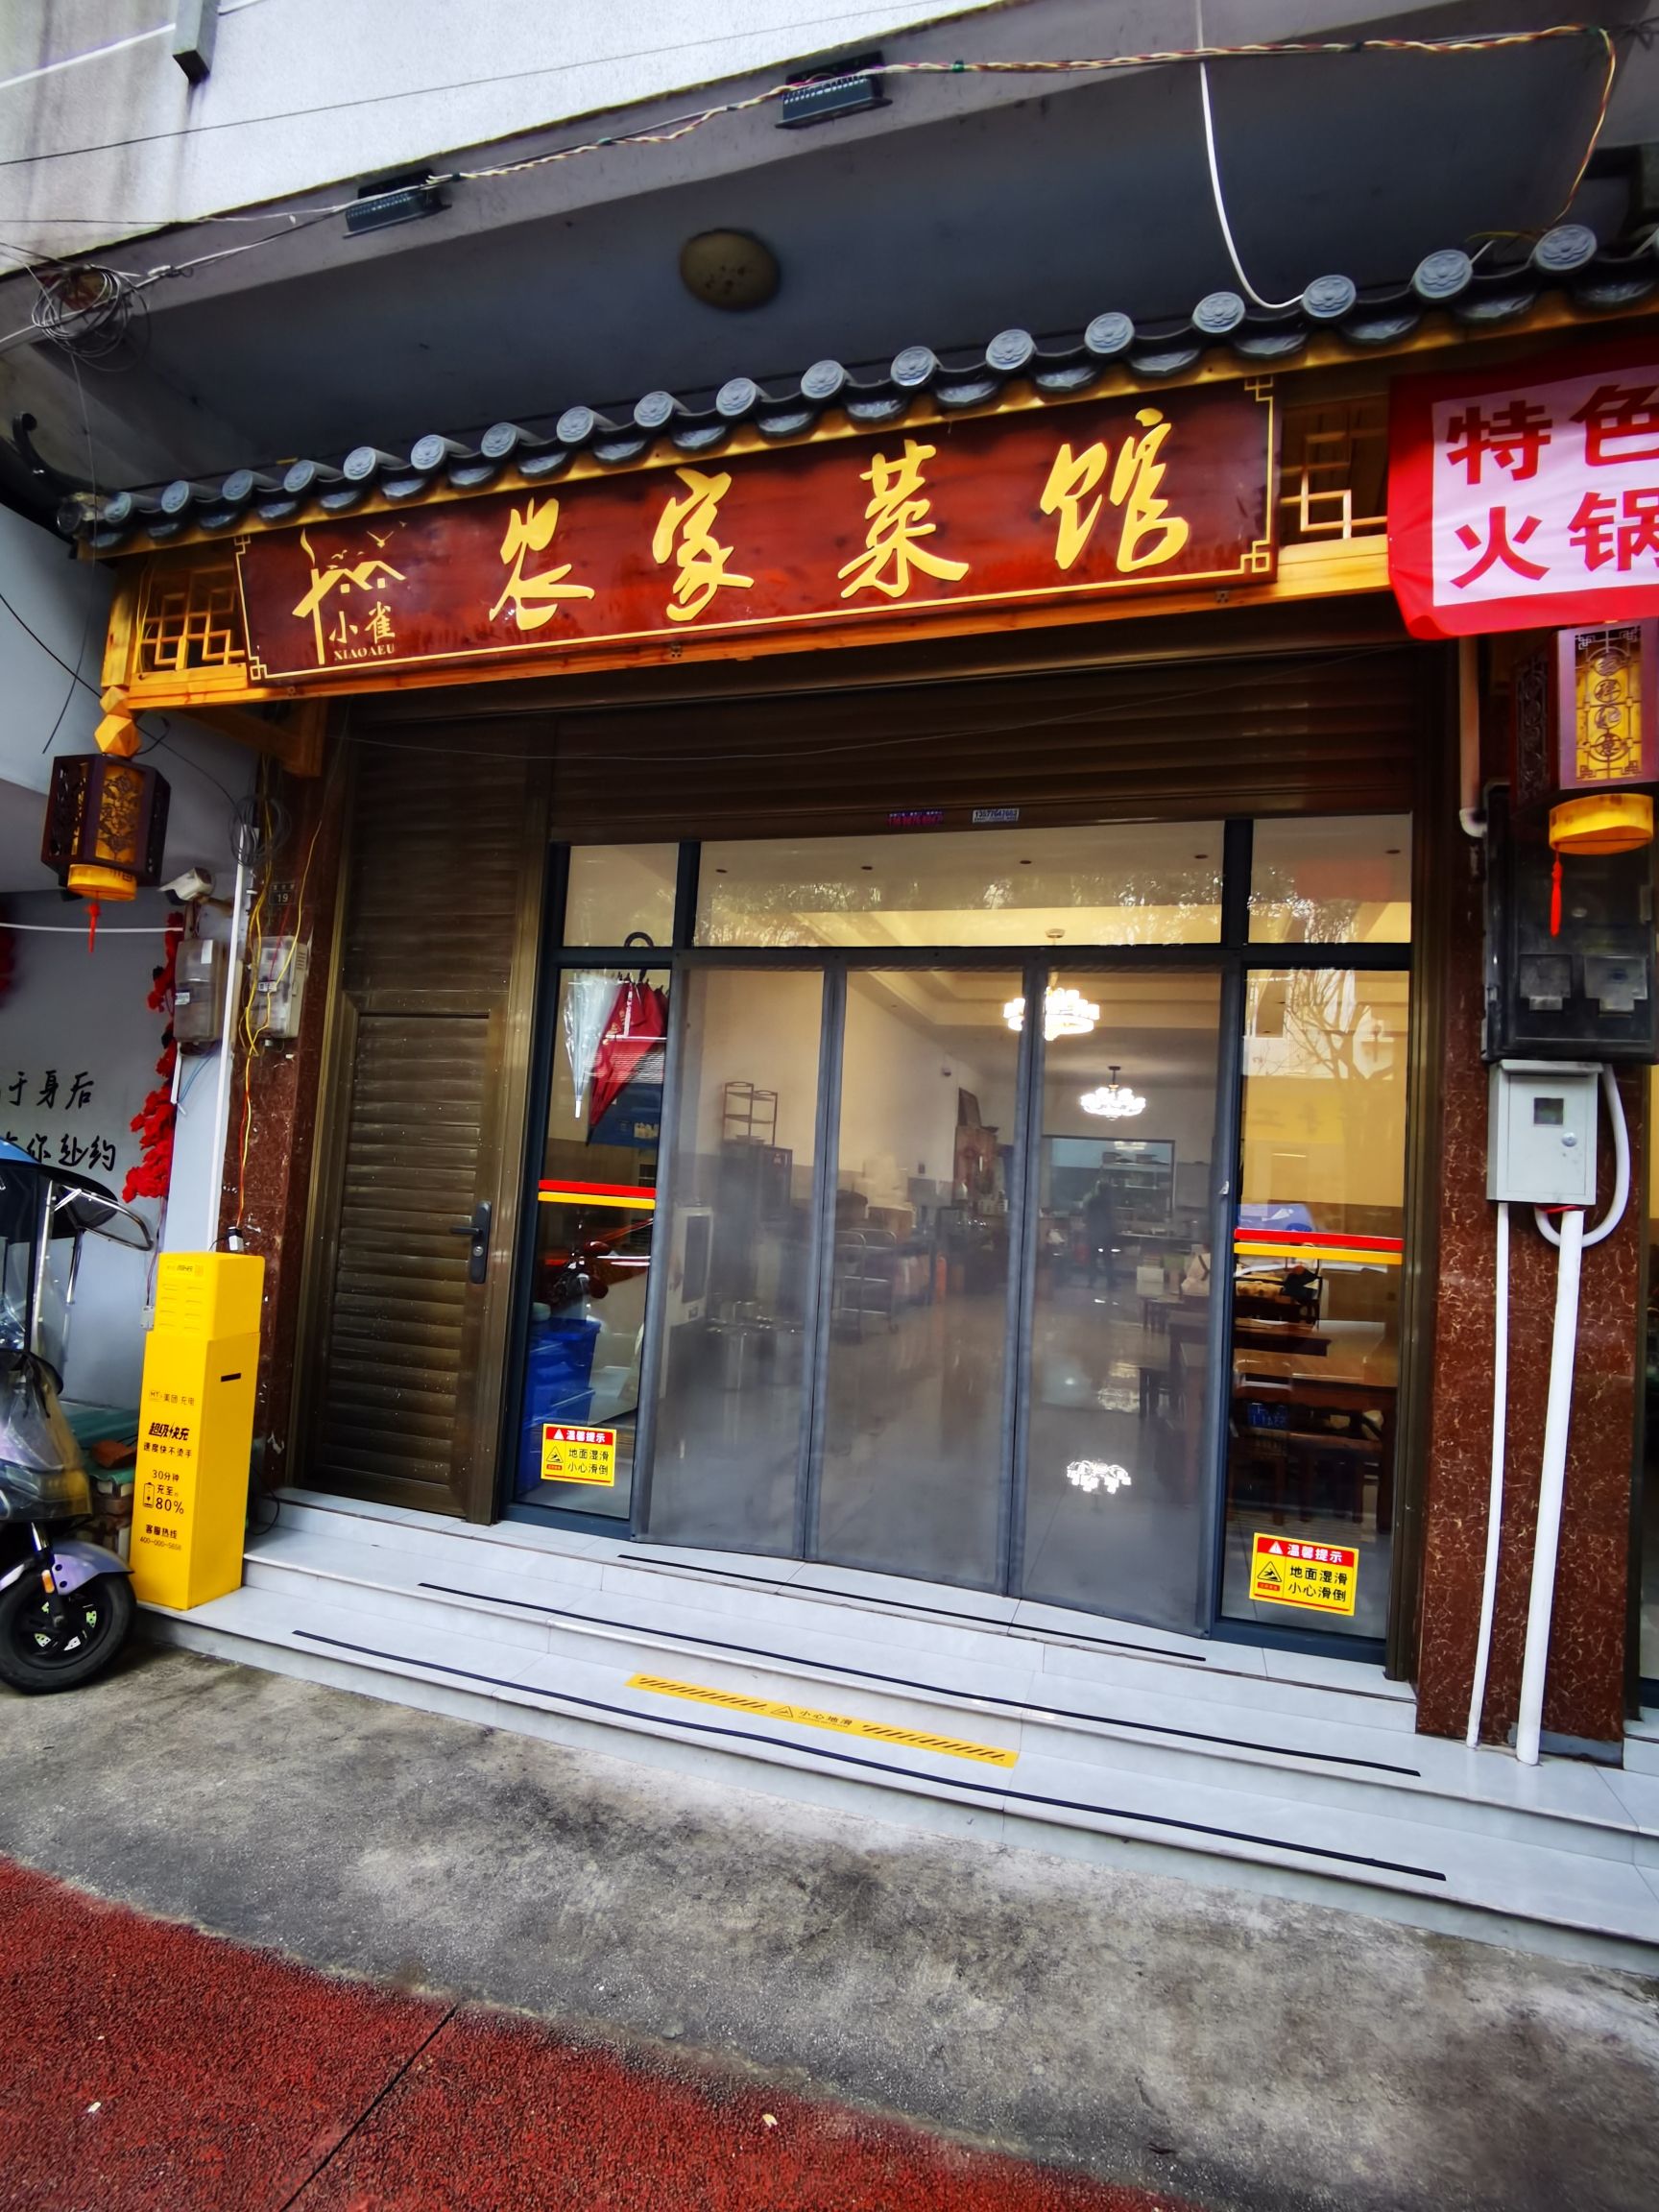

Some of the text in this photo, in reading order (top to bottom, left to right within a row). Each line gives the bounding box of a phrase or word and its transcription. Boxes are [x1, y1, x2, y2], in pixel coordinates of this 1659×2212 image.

[1447, 384, 1659, 485] 特色
[490, 408, 1189, 631] 农家菜馆
[1449, 487, 1659, 589] 火锅
[328, 601, 396, 645] 小雀
[148, 1422, 191, 1441] 超级快充
[565, 1430, 607, 1444] 温馨提示
[144, 1442, 192, 1457] 速度快不烫手
[568, 1448, 610, 1462] 地面湿滑
[152, 1470, 180, 1482] 30分钟
[567, 1462, 609, 1477] 小心滑倒
[156, 1497, 184, 1515] 80%
[146, 1524, 178, 1539] 客服热线
[1287, 1543, 1343, 1564] 温馨提示
[1290, 1565, 1348, 1586] 地面湿滑
[1288, 1581, 1347, 1602] 小心滑倒
[800, 1710, 853, 1726] 小心地滑
